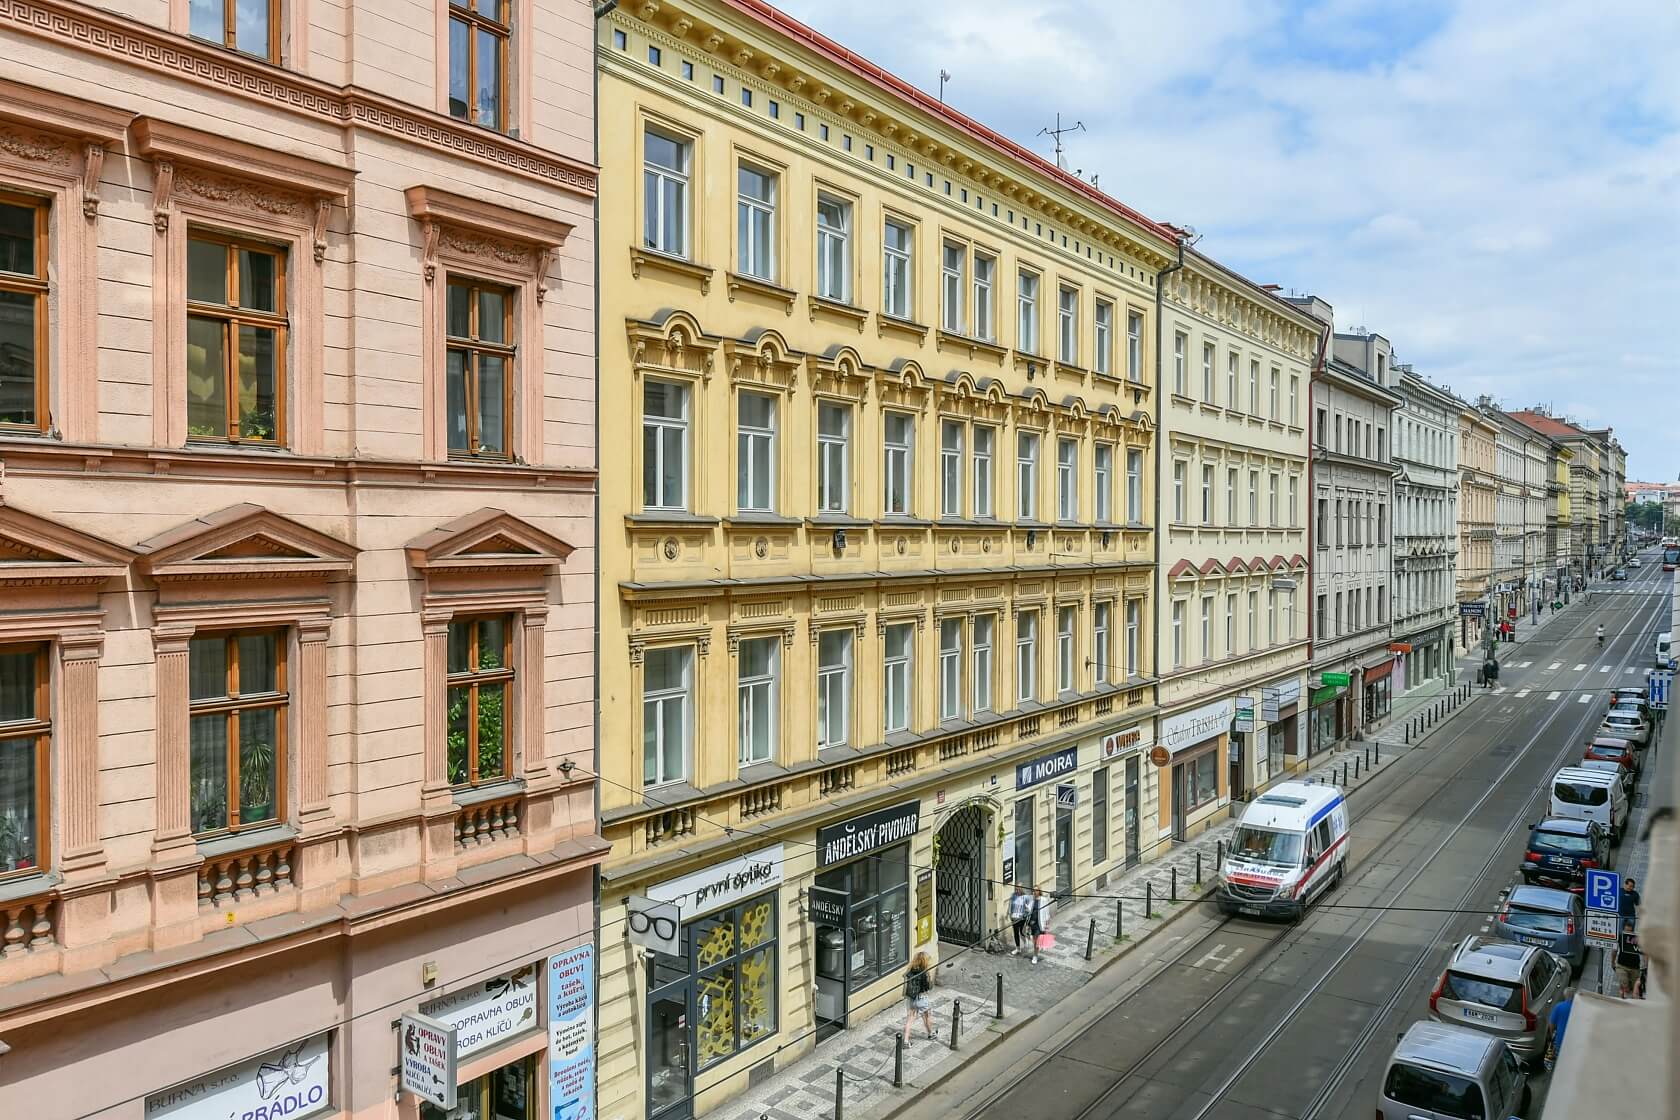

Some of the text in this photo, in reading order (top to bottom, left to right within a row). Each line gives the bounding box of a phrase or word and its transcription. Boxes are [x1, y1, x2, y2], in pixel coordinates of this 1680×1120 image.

[1036, 754, 1073, 779] MOIRA
[825, 814, 917, 865] ANDĚLSKÝ PIVOVAR
[696, 873, 730, 908] první
[1593, 875, 1612, 897] P
[553, 951, 590, 969] OPRAVNA
[560, 964, 584, 979] OBUVI
[452, 992, 534, 1031] OPRAVNA OBUVI
[418, 1028, 447, 1046] OPRAVY
[424, 1042, 446, 1060] OBUVI
[405, 1056, 431, 1076] VÝROBA
[210, 1074, 240, 1089] s.r.o.
